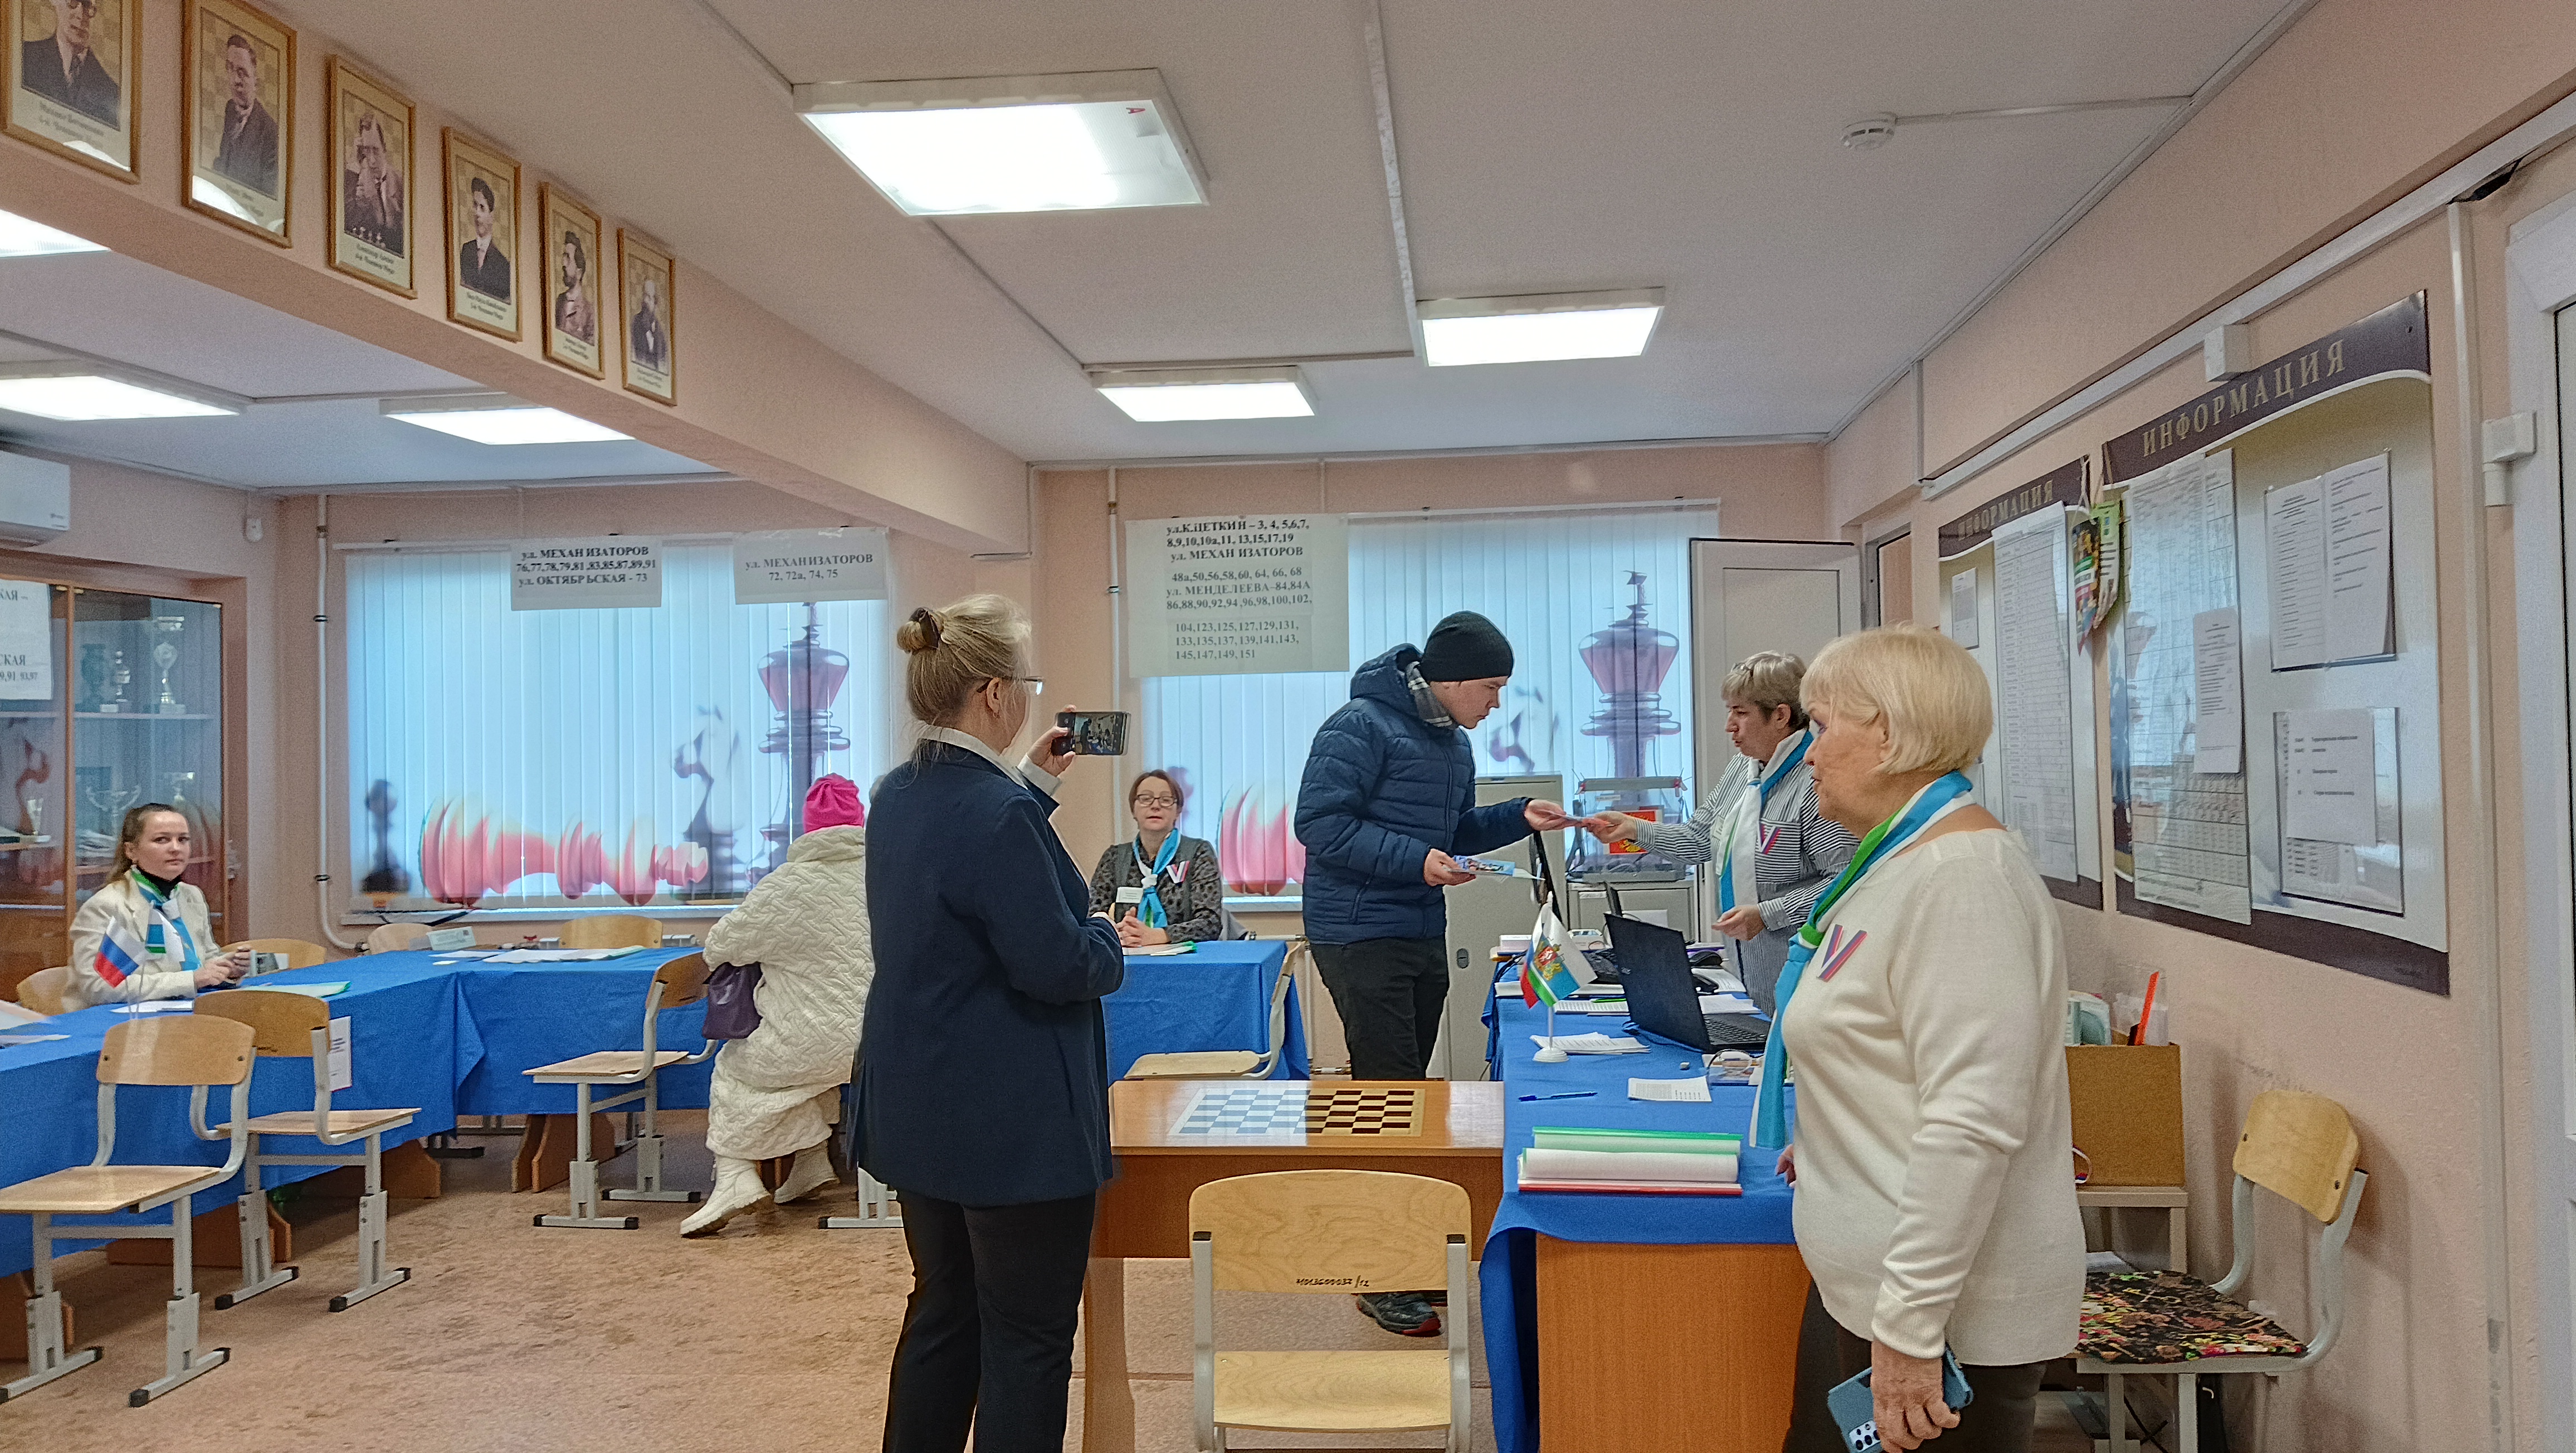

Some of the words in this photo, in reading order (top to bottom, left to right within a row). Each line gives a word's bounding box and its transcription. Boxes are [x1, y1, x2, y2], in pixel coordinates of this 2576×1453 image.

[2142, 339, 2345, 457] ИНФОРМАЦИЯ
[636, 573, 647, 582] 73
[769, 572, 783, 581] 72,
[809, 569, 824, 580] 74,
[826, 569, 838, 578] 75
[1290, 567, 1302, 577] 68
